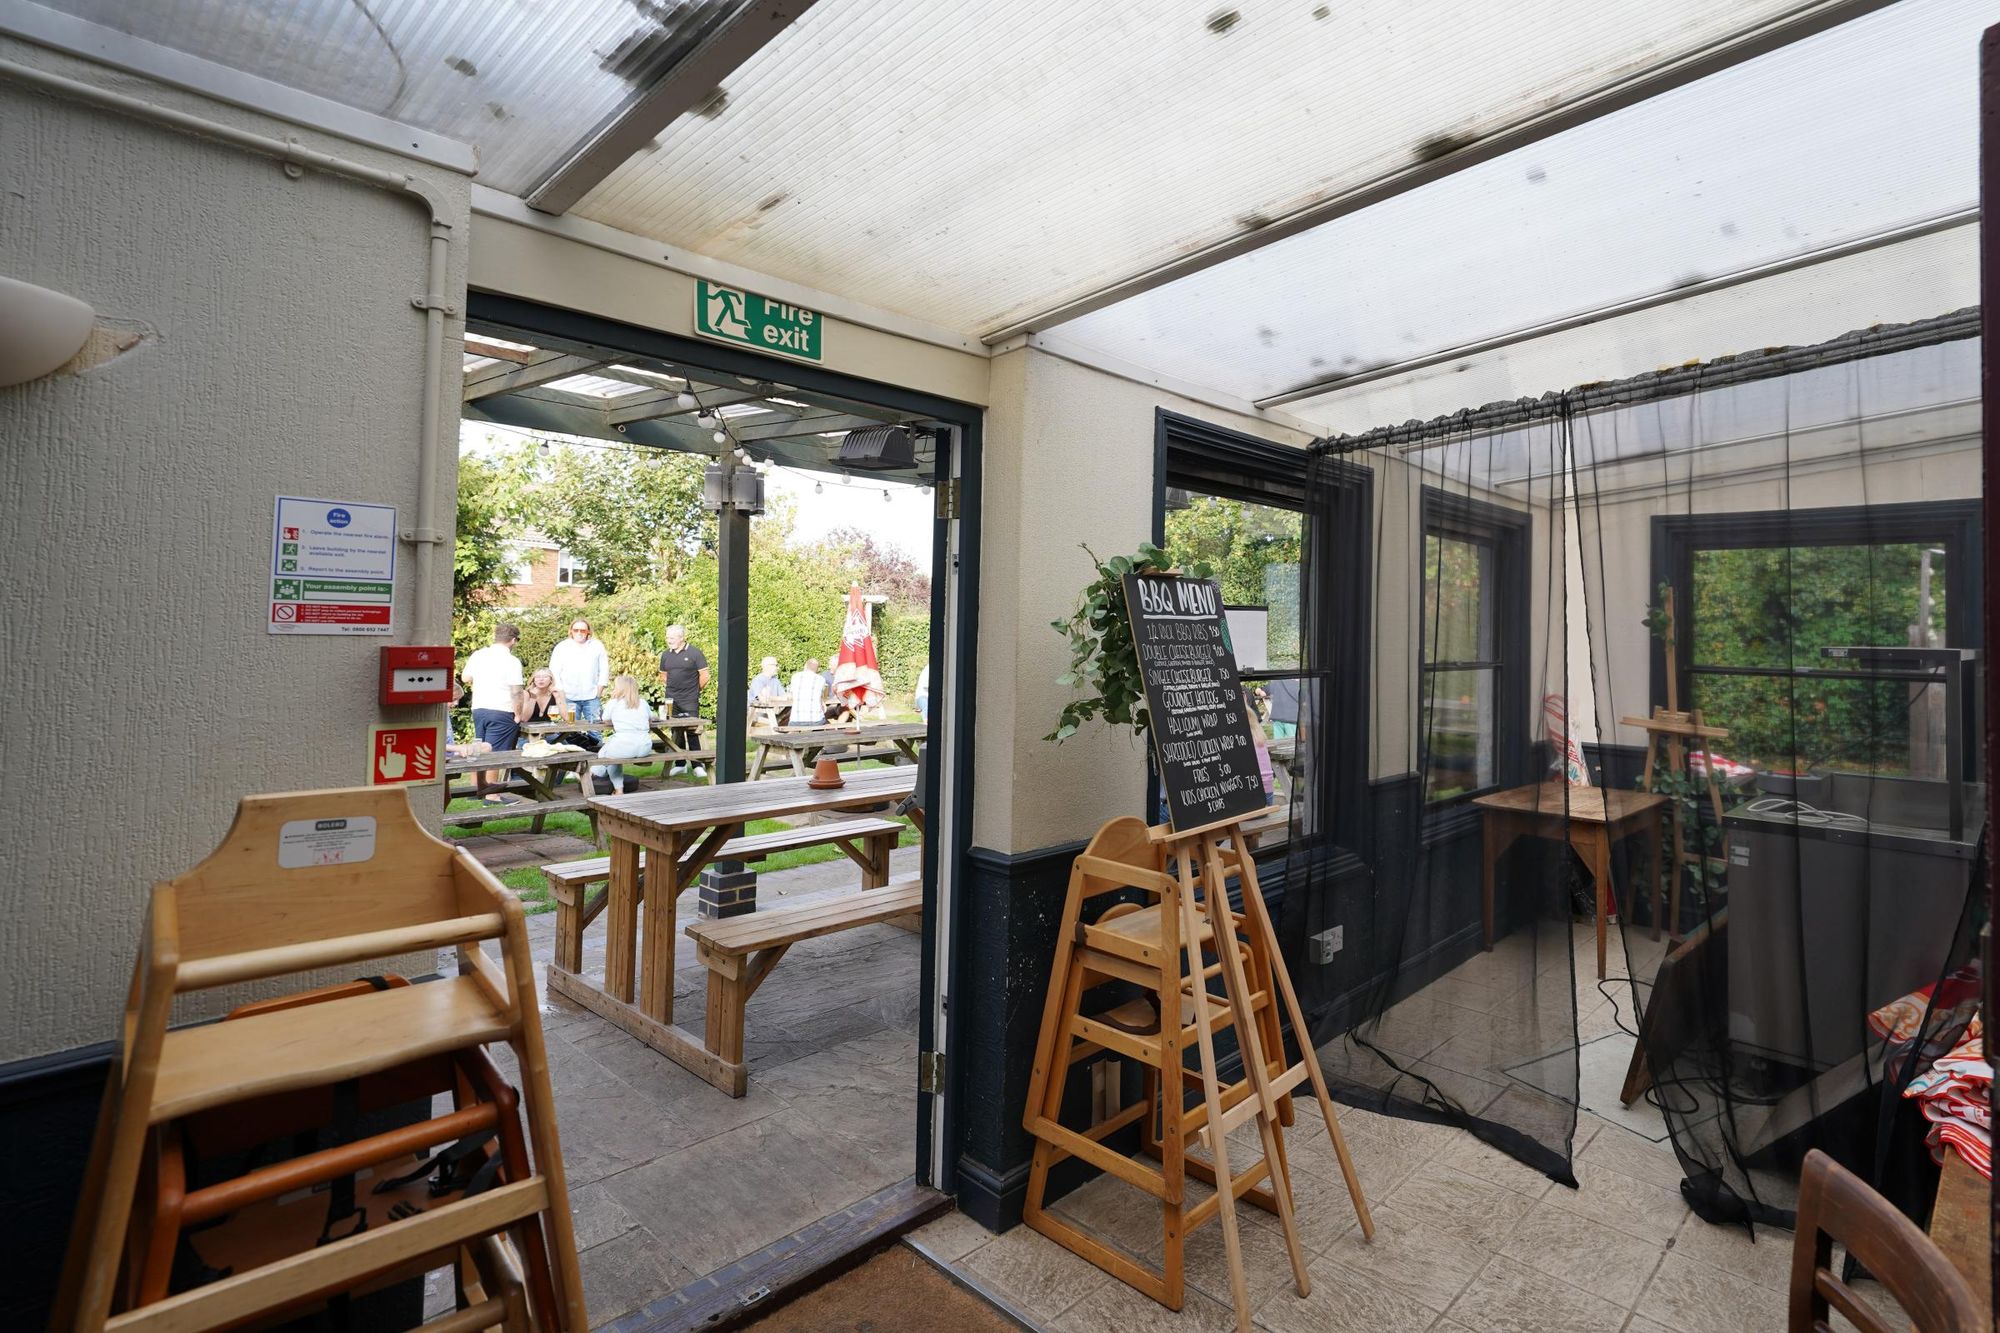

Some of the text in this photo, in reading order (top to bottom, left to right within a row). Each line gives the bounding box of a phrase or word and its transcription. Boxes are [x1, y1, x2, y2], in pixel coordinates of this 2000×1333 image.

[764, 299, 813, 326] Fire
[763, 324, 809, 352] exit
[323, 584, 357, 592] assembly
[1137, 578, 1216, 615] BBQ MENU
[1175, 623, 1192, 641] BBQ
[1192, 623, 1209, 641] RIBS
[1141, 643, 1168, 661] DOUBLE
[1148, 668, 1171, 686] SINGLE
[1162, 690, 1195, 711] GOURMET
[1167, 716, 1202, 735] HALLOUMI
[1201, 712, 1218, 728] WRAP
[1162, 739, 1197, 764] SHREDDED
[1197, 738, 1221, 759] CHICKEN
[1219, 735, 1235, 751] WRAP
[1192, 766, 1210, 784] FRIES
[1180, 789, 1197, 807] KIDS
[1196, 782, 1221, 802] CHICKEN
[1220, 775, 1244, 794] NUGGETS
[1212, 797, 1226, 812] CHIPS
